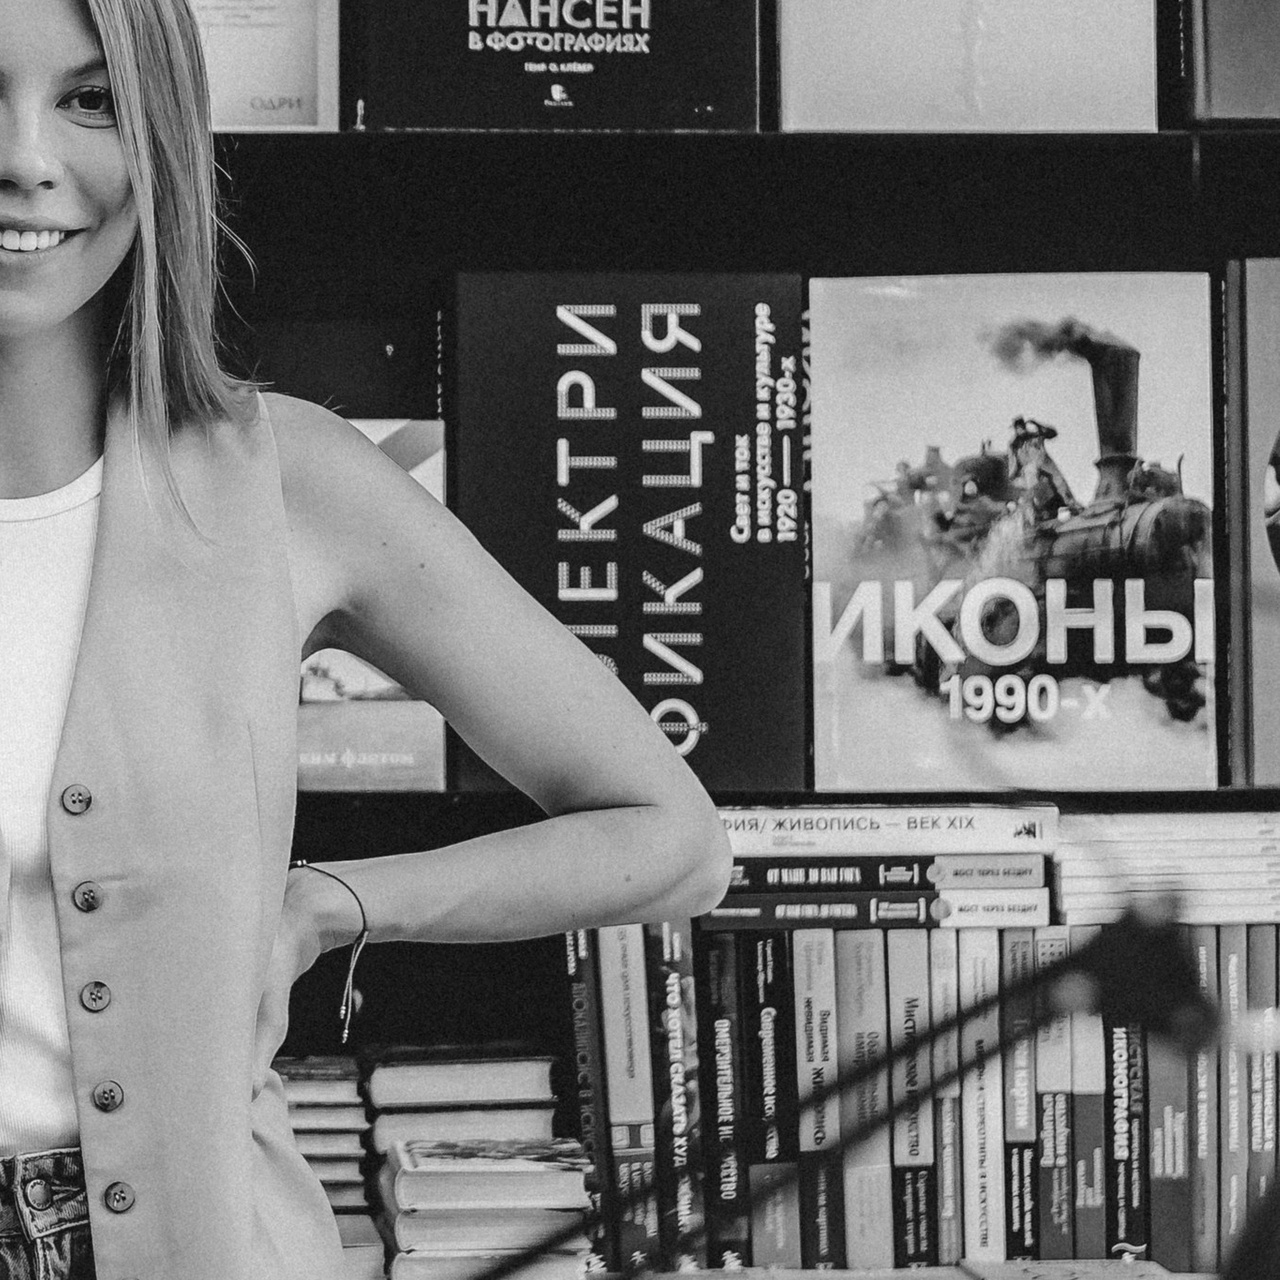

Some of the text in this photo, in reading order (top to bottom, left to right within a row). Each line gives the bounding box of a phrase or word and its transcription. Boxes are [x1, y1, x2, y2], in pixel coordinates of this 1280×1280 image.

[468, 30, 650, 54] В ФОТОГРАФИЯХ
[754, 302, 776, 402] культуре
[557, 304, 620, 675] ЕКТРИ
[735, 433, 751, 473] ток
[755, 421, 778, 527] искусстве
[729, 491, 751, 544] Свет
[776, 488, 798, 544] 1920
[813, 576, 1214, 666] ИКОНЫ
[907, 815, 941, 831] ВЕК
[947, 815, 975, 831] XIX
[714, 1019, 735, 1123] ОМЕРЗИТЕЛЬНОЕ
[758, 1007, 777, 1095] Современное
[1113, 1026, 1129, 1160] ИКОНОГРАФИЯ
